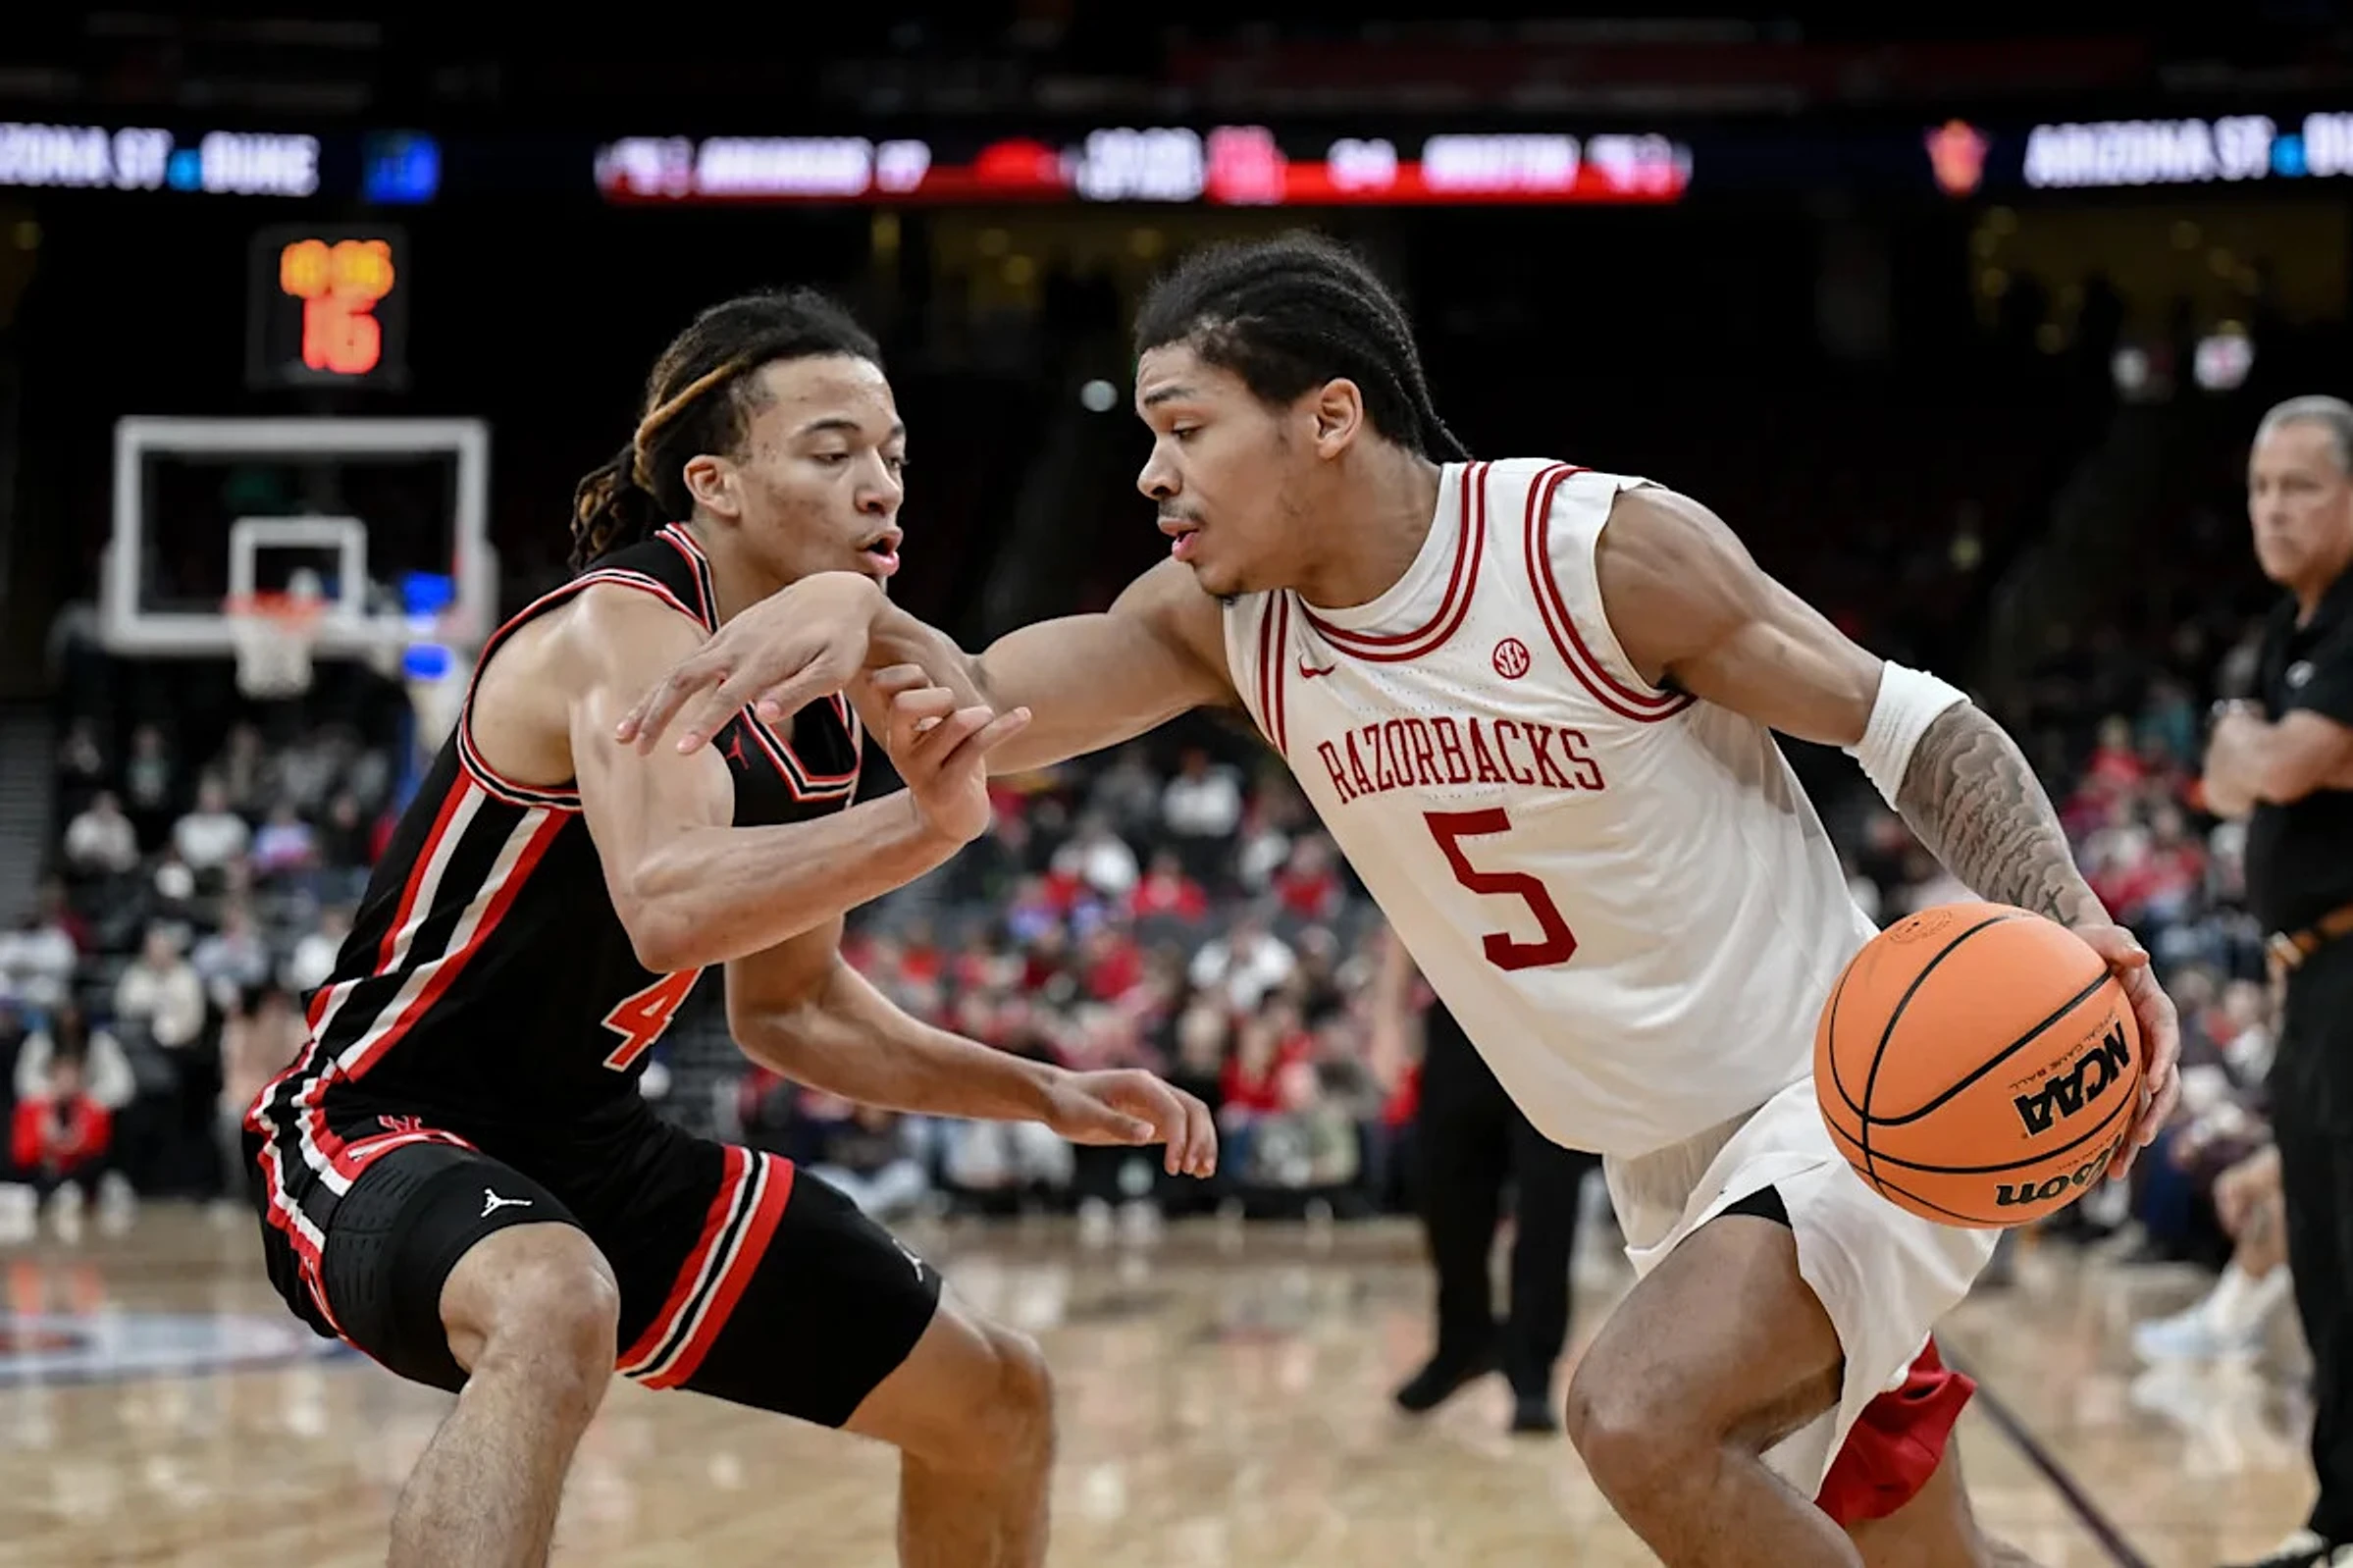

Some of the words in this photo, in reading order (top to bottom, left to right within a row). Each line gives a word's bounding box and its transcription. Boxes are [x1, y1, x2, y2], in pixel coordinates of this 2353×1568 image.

[1494, 641, 1528, 677] SEC
[1317, 716, 1606, 805] RAZORBACKS
[1423, 807, 1578, 971] 5
[600, 966, 705, 1072] 4
[2013, 1020, 2131, 1136] NCAA
